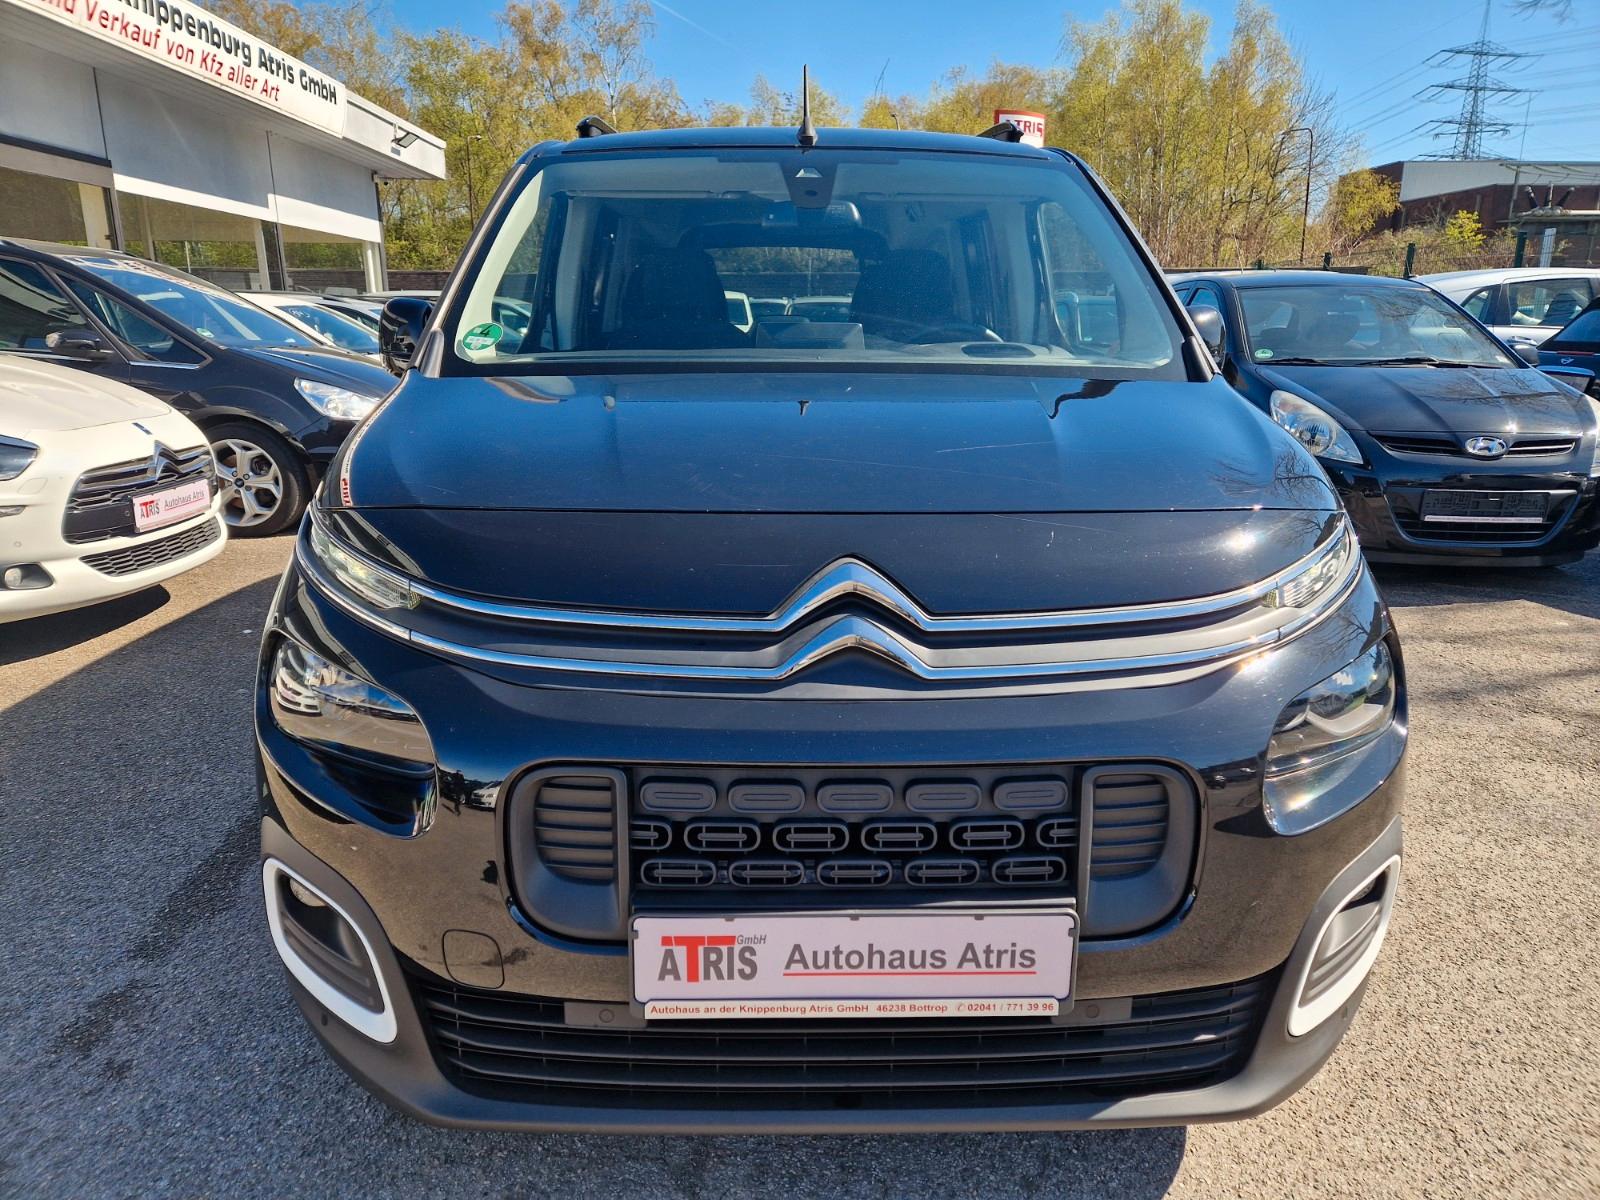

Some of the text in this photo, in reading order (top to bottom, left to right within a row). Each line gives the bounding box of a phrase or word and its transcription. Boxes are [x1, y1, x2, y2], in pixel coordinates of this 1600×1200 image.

[85, 0, 161, 49] Verkauf
[166, 38, 194, 65] von
[200, 49, 224, 77] Kfz
[227, 65, 258, 91] aller
[260, 79, 281, 101] Art
[257, 47, 295, 85] Atris
[299, 69, 337, 105] GmbH
[139, 500, 160, 519] ATRIS
[164, 494, 192, 508] Autohaus
[657, 934, 768, 983] ATRIS GmbH
[784, 942, 1036, 970] Autohaus Atris
[650, 1005, 700, 1014] Autohaus
[703, 1006, 716, 1014] an
[719, 1005, 736, 1014] der
[739, 1004, 806, 1015] Knippenburg
[809, 1004, 833, 1013] Atris
[836, 1004, 869, 1013] GmbH
[876, 1004, 906, 1013] 46238
[909, 1003, 948, 1014] Bottrop
[967, 1003, 997, 1012] 02041
[1006, 1003, 1024, 1012] 771
[1027, 1003, 1039, 1012] 39
[1042, 1003, 1054, 1012] 96
